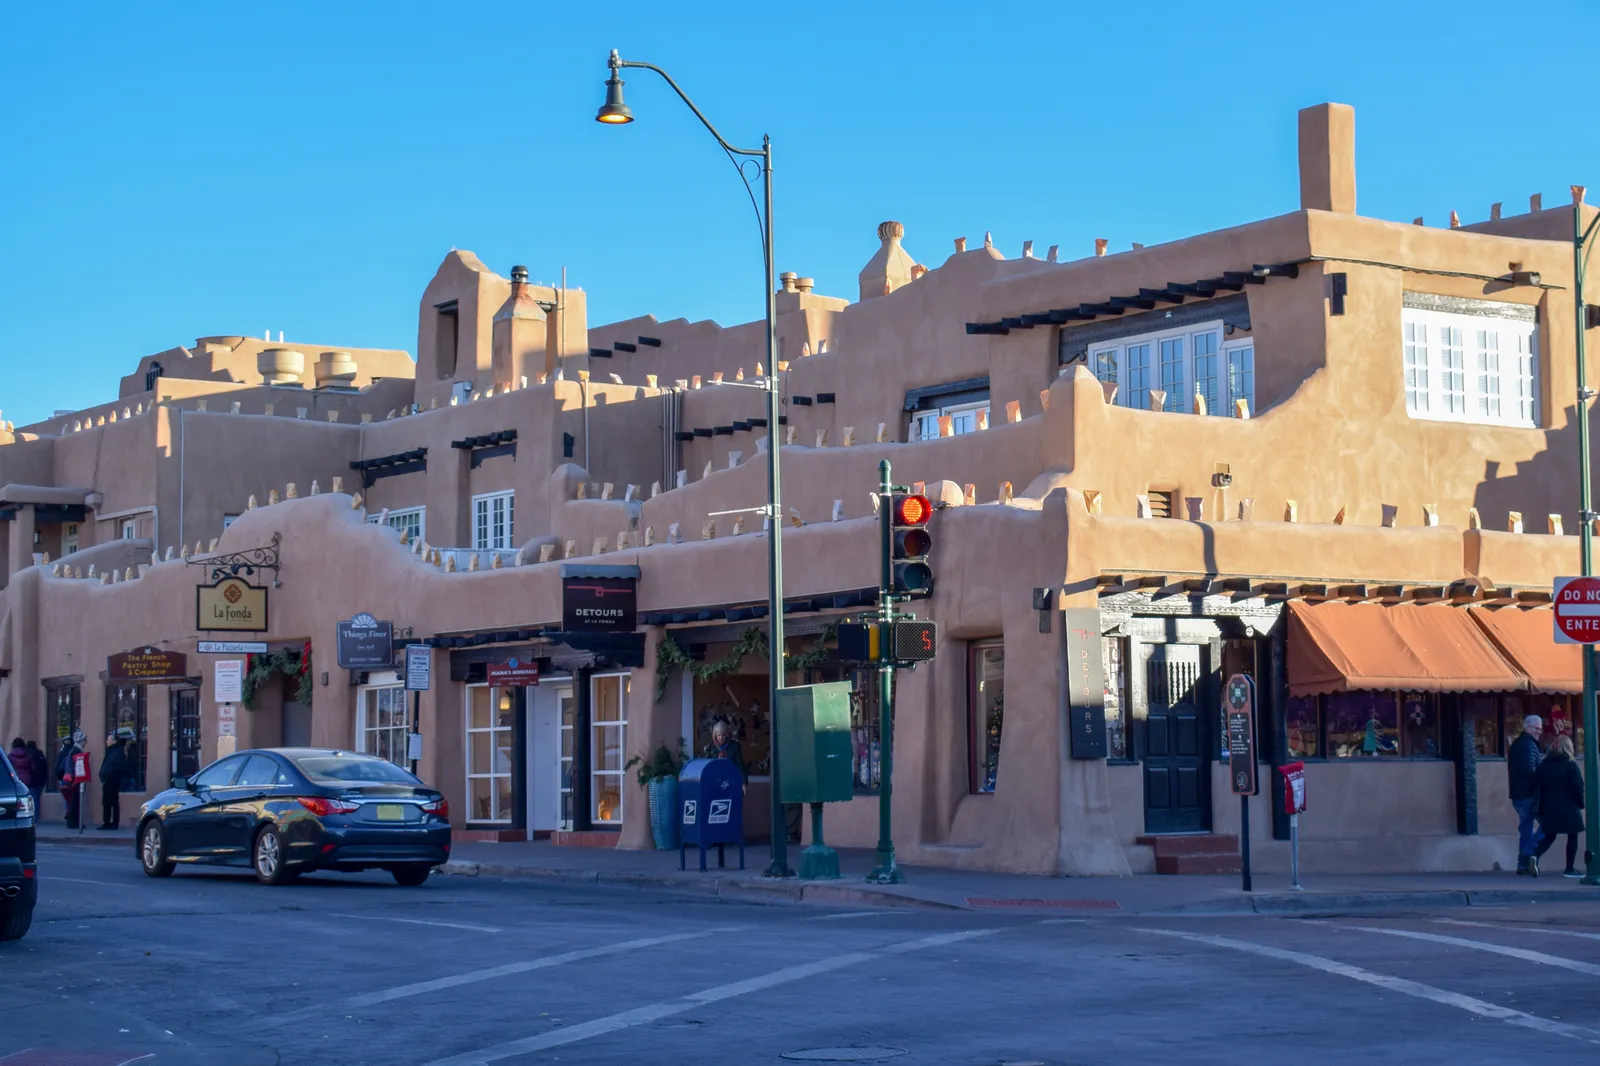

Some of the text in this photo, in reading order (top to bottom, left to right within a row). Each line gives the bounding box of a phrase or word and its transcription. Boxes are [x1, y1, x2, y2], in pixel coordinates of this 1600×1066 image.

[1564, 589, 1581, 601] DO
[213, 604, 252, 621] La Fonda
[575, 608, 624, 617] DETOURS
[343, 630, 388, 640] Things Finer
[921, 629, 932, 651] 5
[151, 661, 172, 669] Shop
[1081, 650, 1093, 733] DETOURS
